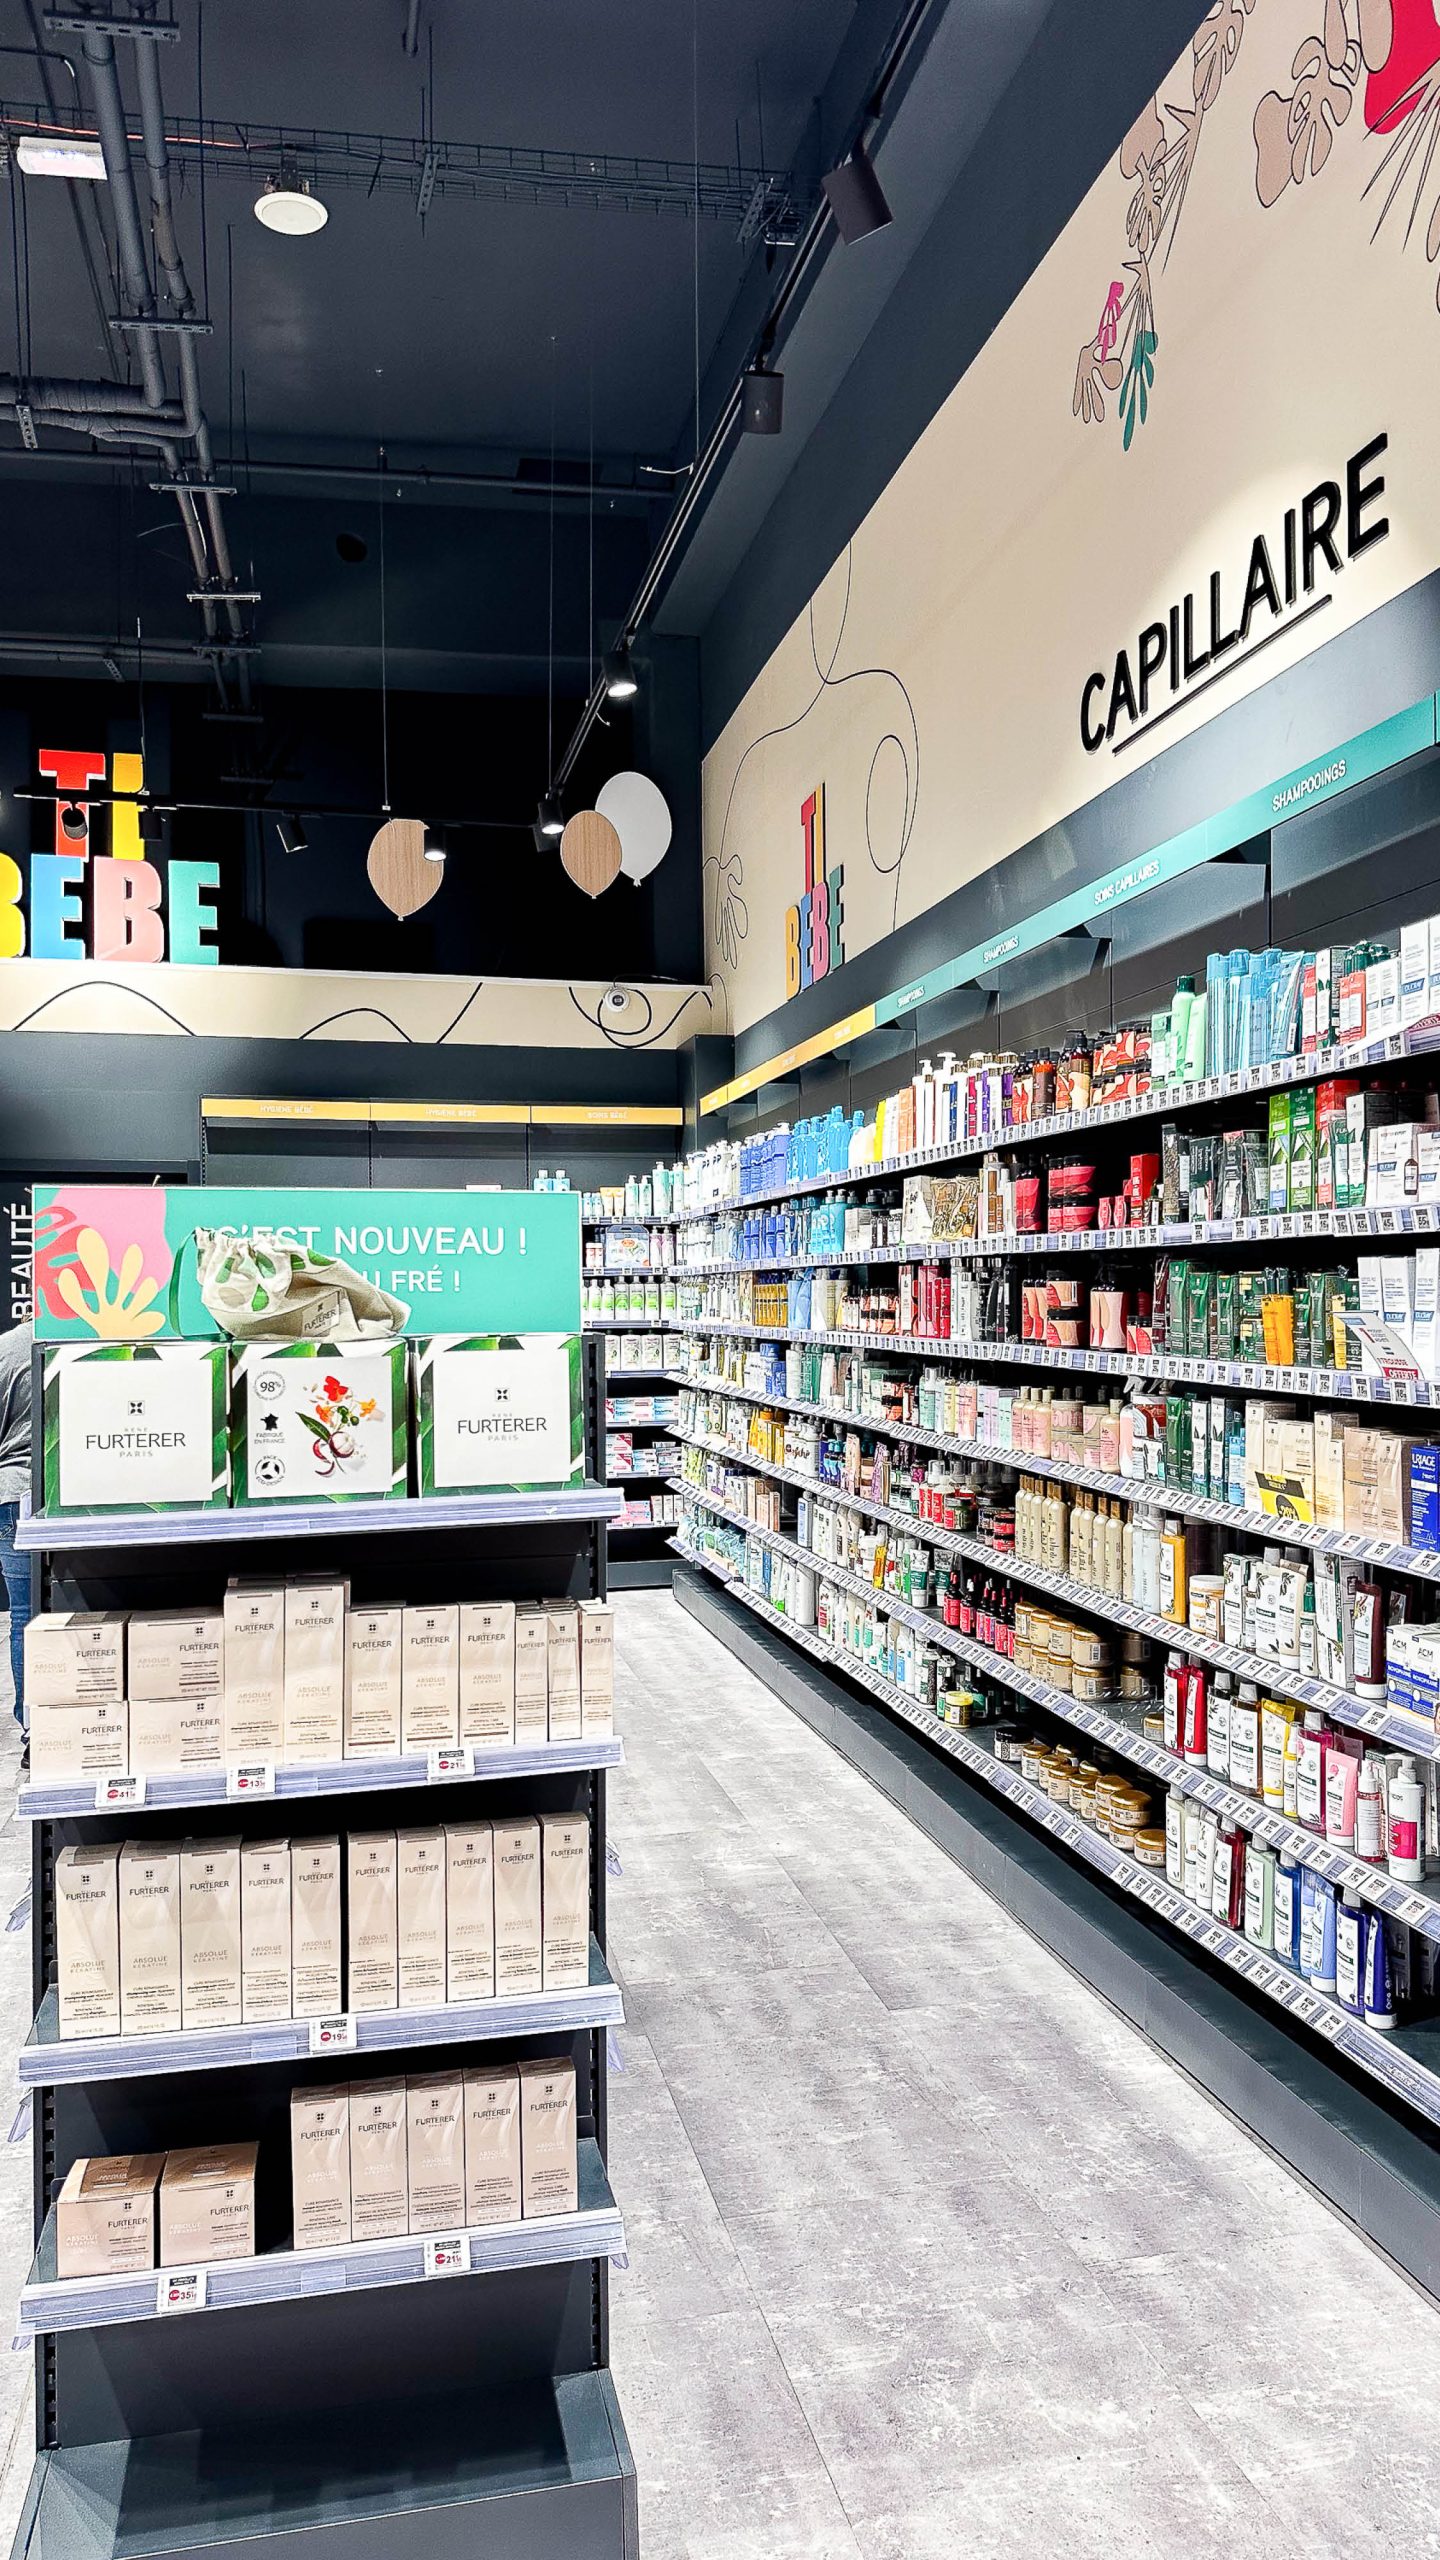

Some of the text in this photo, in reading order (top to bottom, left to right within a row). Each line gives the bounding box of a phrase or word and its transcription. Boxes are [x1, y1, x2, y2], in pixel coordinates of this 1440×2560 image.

[1081, 432, 1389, 753] CAPILLAIRE
[1271, 758, 1347, 813] SHAMPOOINGS
[784, 862, 845, 1001] BEBE
[334, 1226, 505, 1255] NOUVEAU
[3, 1203, 34, 1320] BEAUTÉ
[391, 1264, 443, 1292] FRÉ
[457, 1417, 548, 1434] FURTERER
[86, 1433, 186, 1449] FURTERER
[1412, 1453, 1436, 1467] URIAGE
[295, 1617, 334, 1626] FURTERER
[235, 1623, 275, 1632] FURTERER
[411, 1635, 450, 1645] FURTERER
[467, 1633, 506, 1642] FURTERER
[179, 1642, 219, 1652] FURTERER
[352, 1640, 392, 1650] FURTERER
[1392, 1638, 1407, 1650] ACM
[76, 1649, 117, 1658] FURTERER
[1417, 1647, 1434, 1658] ACM
[180, 1718, 220, 1728] FURTERER
[81, 1725, 123, 1735] FURTERER
[453, 1857, 487, 1867] FURTERER
[355, 1866, 390, 1876] FURTERER
[404, 1864, 439, 1873] FURTERER
[248, 1877, 284, 1887] FURTERER
[299, 1872, 334, 1882] FURTERER
[190, 1879, 229, 1891] FURTERER
[65, 1890, 106, 1901] FURTERER
[129, 1886, 169, 1896] FURTERER
[530, 2100, 568, 2111] FURTERER
[473, 2108, 511, 2119] FURTERER
[415, 2115, 454, 2126] FURTERER
[358, 2121, 397, 2132] FURTERER
[300, 2128, 340, 2139] FURTERER
[210, 2204, 249, 2216] FURTERER
[108, 2217, 148, 2229] FURTERER
